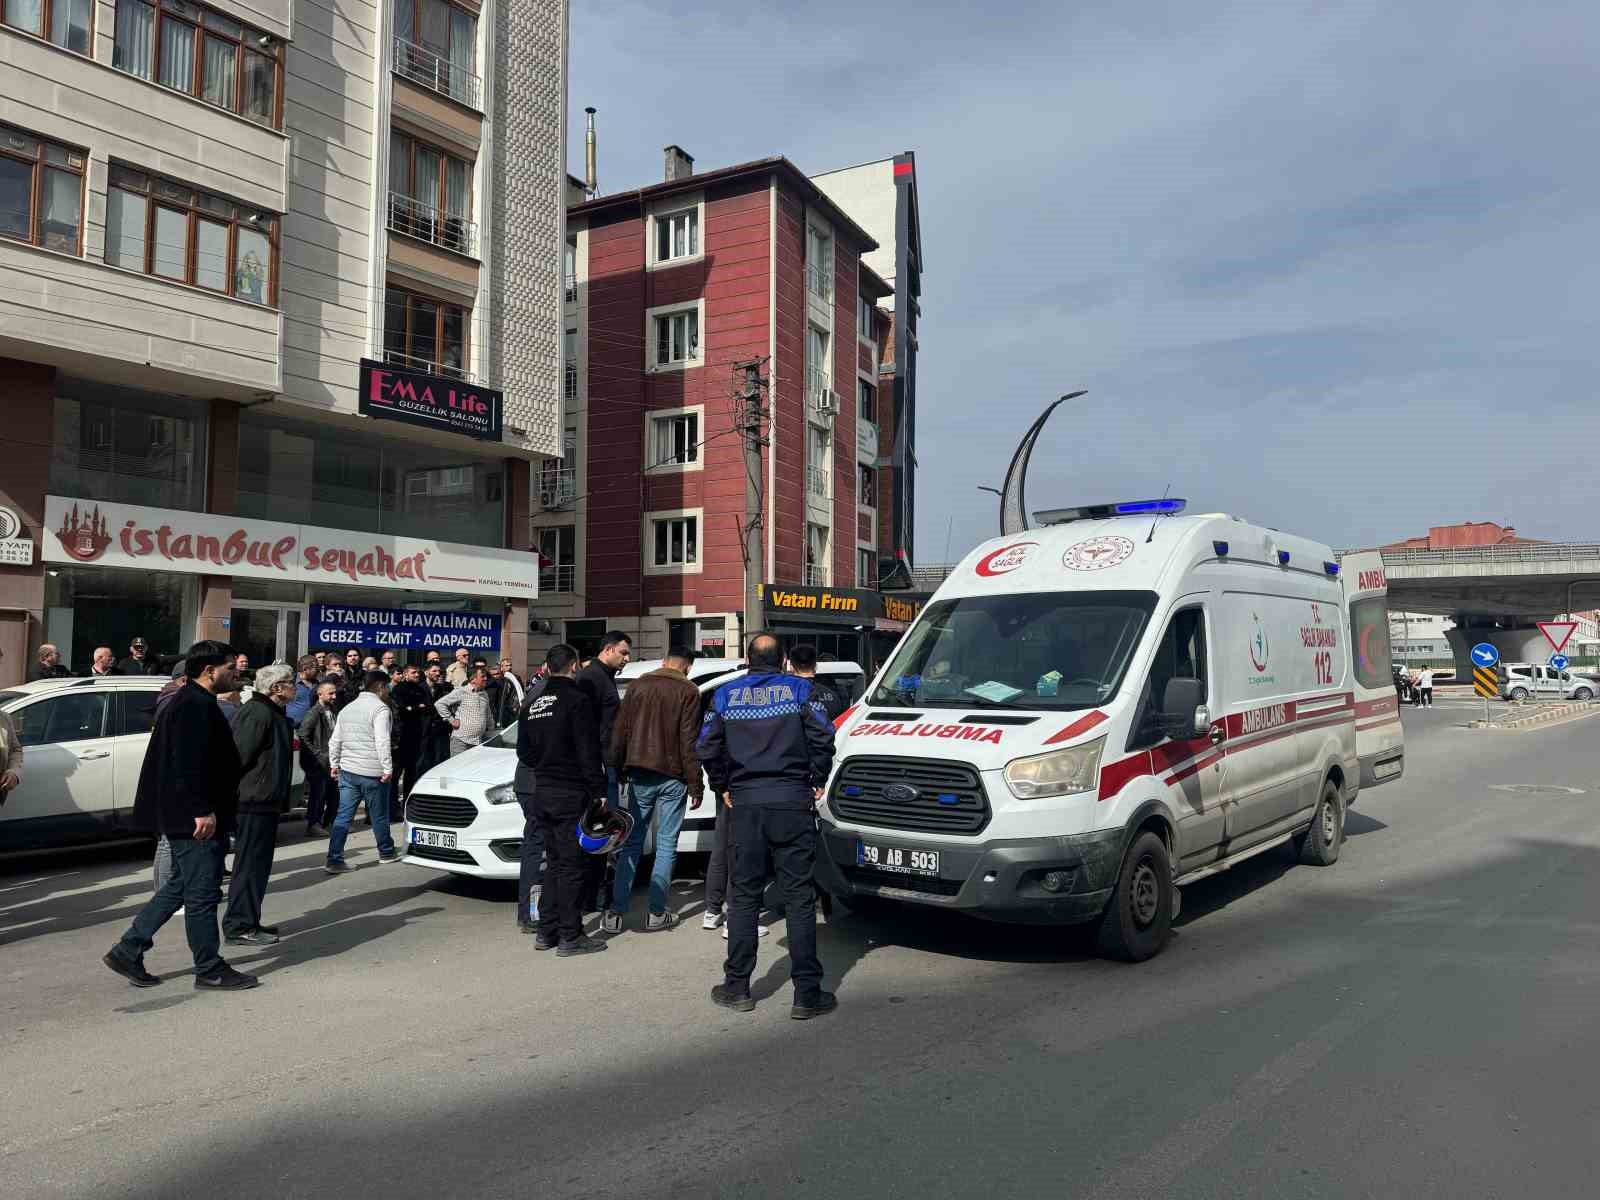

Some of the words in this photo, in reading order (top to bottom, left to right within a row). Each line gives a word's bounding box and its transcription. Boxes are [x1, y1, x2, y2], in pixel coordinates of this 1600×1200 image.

[369, 368, 436, 405] EMA
[448, 389, 488, 415] Life
[303, 545, 426, 582] seyahat
[772, 591, 817, 610] Vatan
[821, 593, 857, 611] Fırın
[884, 595, 912, 621] Vatan
[320, 605, 398, 626] İSTANBUL
[402, 612, 492, 630] HAVALİMANI
[319, 629, 363, 644] GEBZE
[423, 633, 492, 648] ADAPAZARI
[1315, 652, 1333, 685] 112
[727, 685, 794, 707] ZABITA
[1241, 703, 1287, 734] AMBULANS
[416, 831, 425, 844] 34
[863, 845, 879, 863] 59
[886, 848, 903, 866] AB
[911, 851, 937, 870] 503
